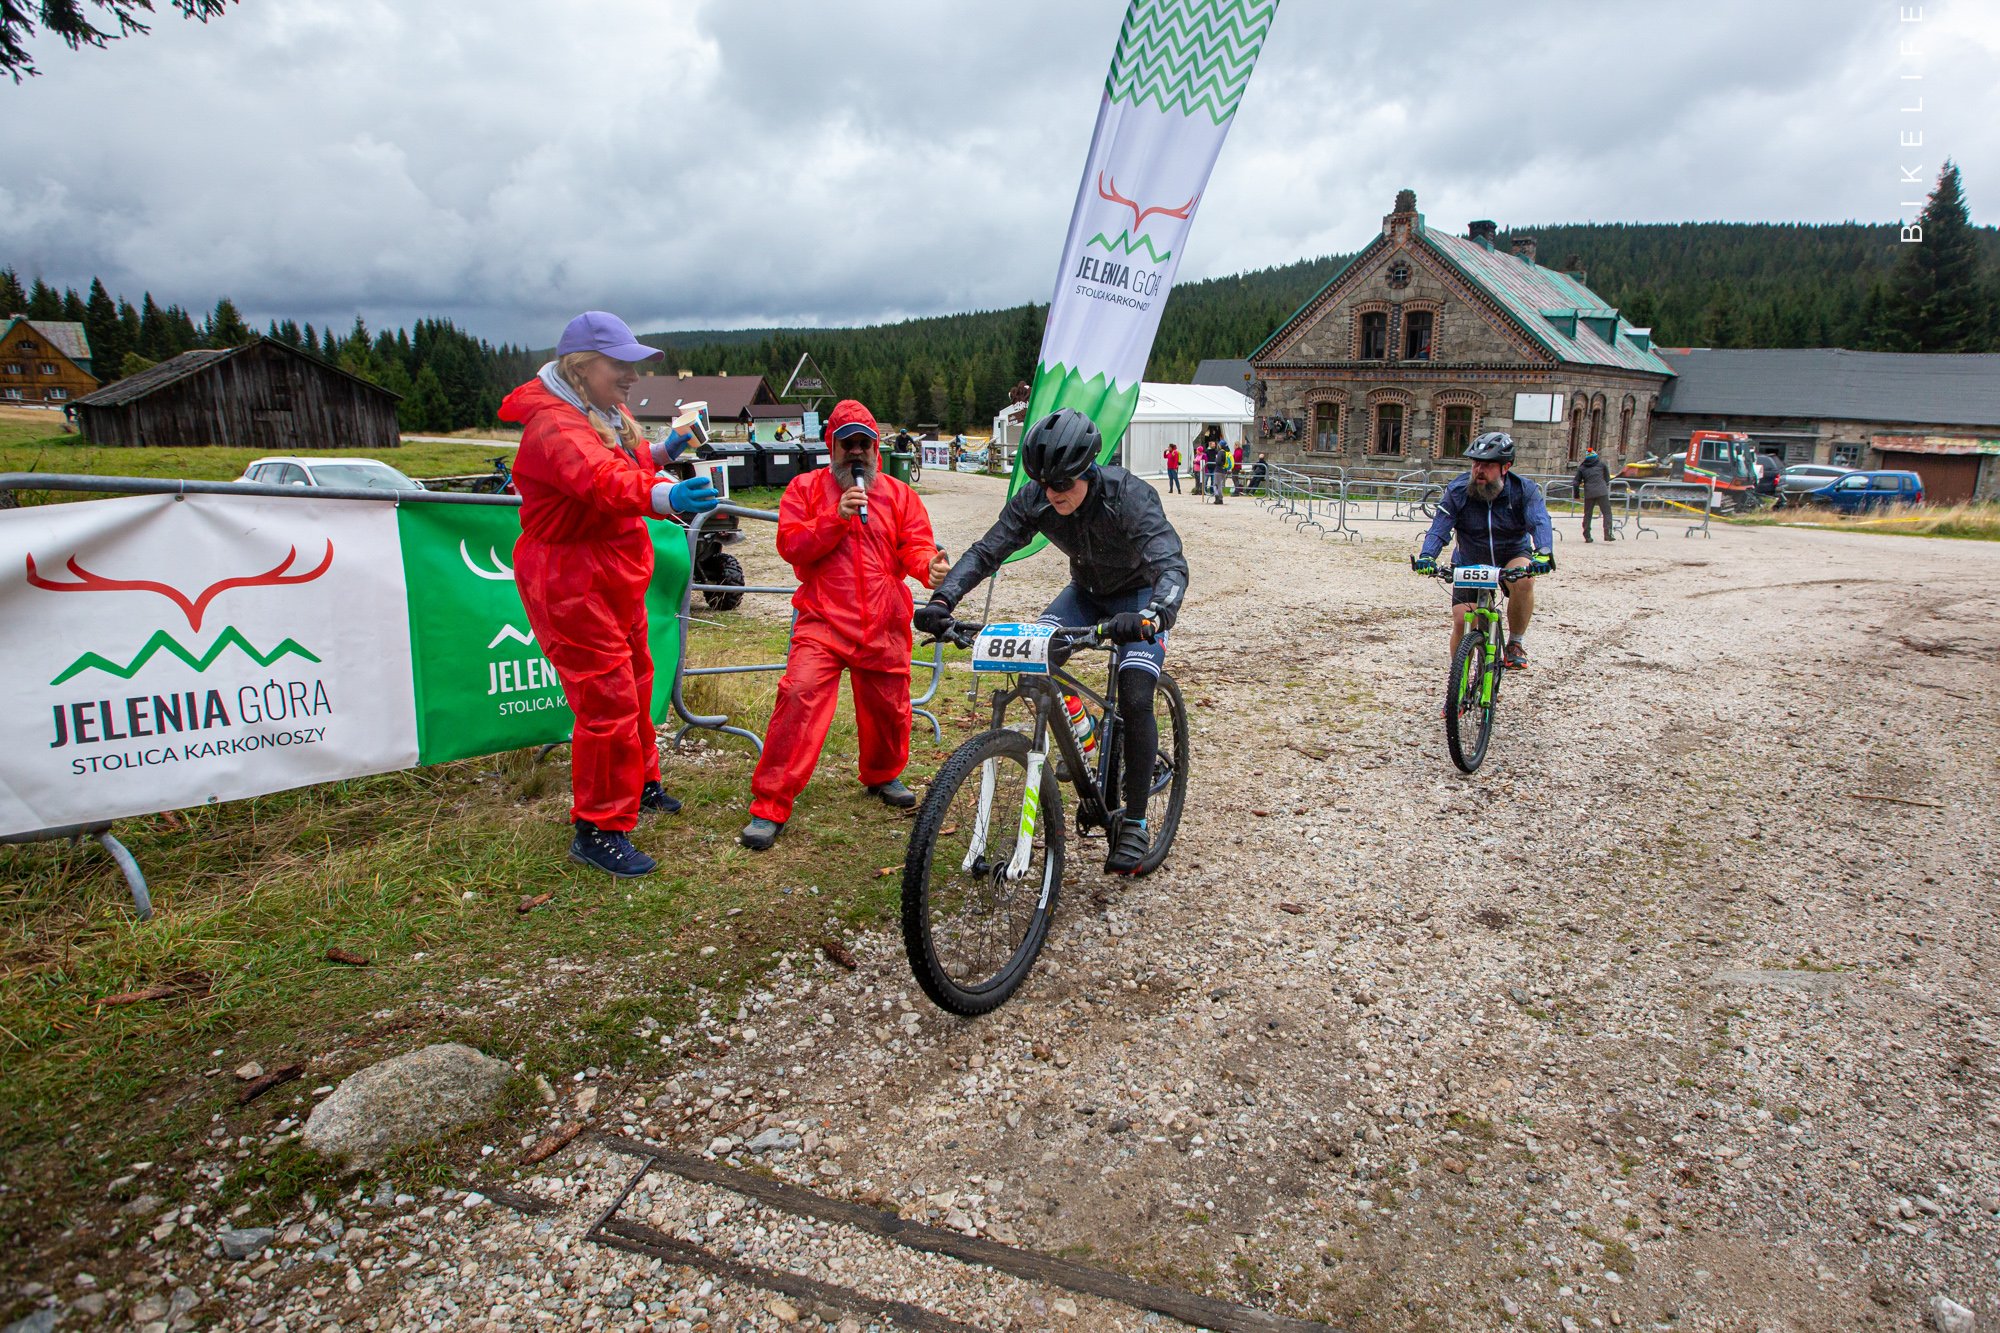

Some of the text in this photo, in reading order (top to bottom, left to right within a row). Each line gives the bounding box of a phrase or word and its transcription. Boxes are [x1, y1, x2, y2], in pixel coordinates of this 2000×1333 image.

[1075, 256, 1130, 290] JELENIA
[1463, 570, 1489, 581] 653
[988, 638, 1032, 659] 884
[1126, 650, 1155, 660] Santini
[487, 657, 562, 696] JELEN
[49, 678, 333, 749] JELENIA GÓRA
[498, 696, 555, 716] STOLICA
[71, 726, 327, 776] STOLICA KARKONOSZY
